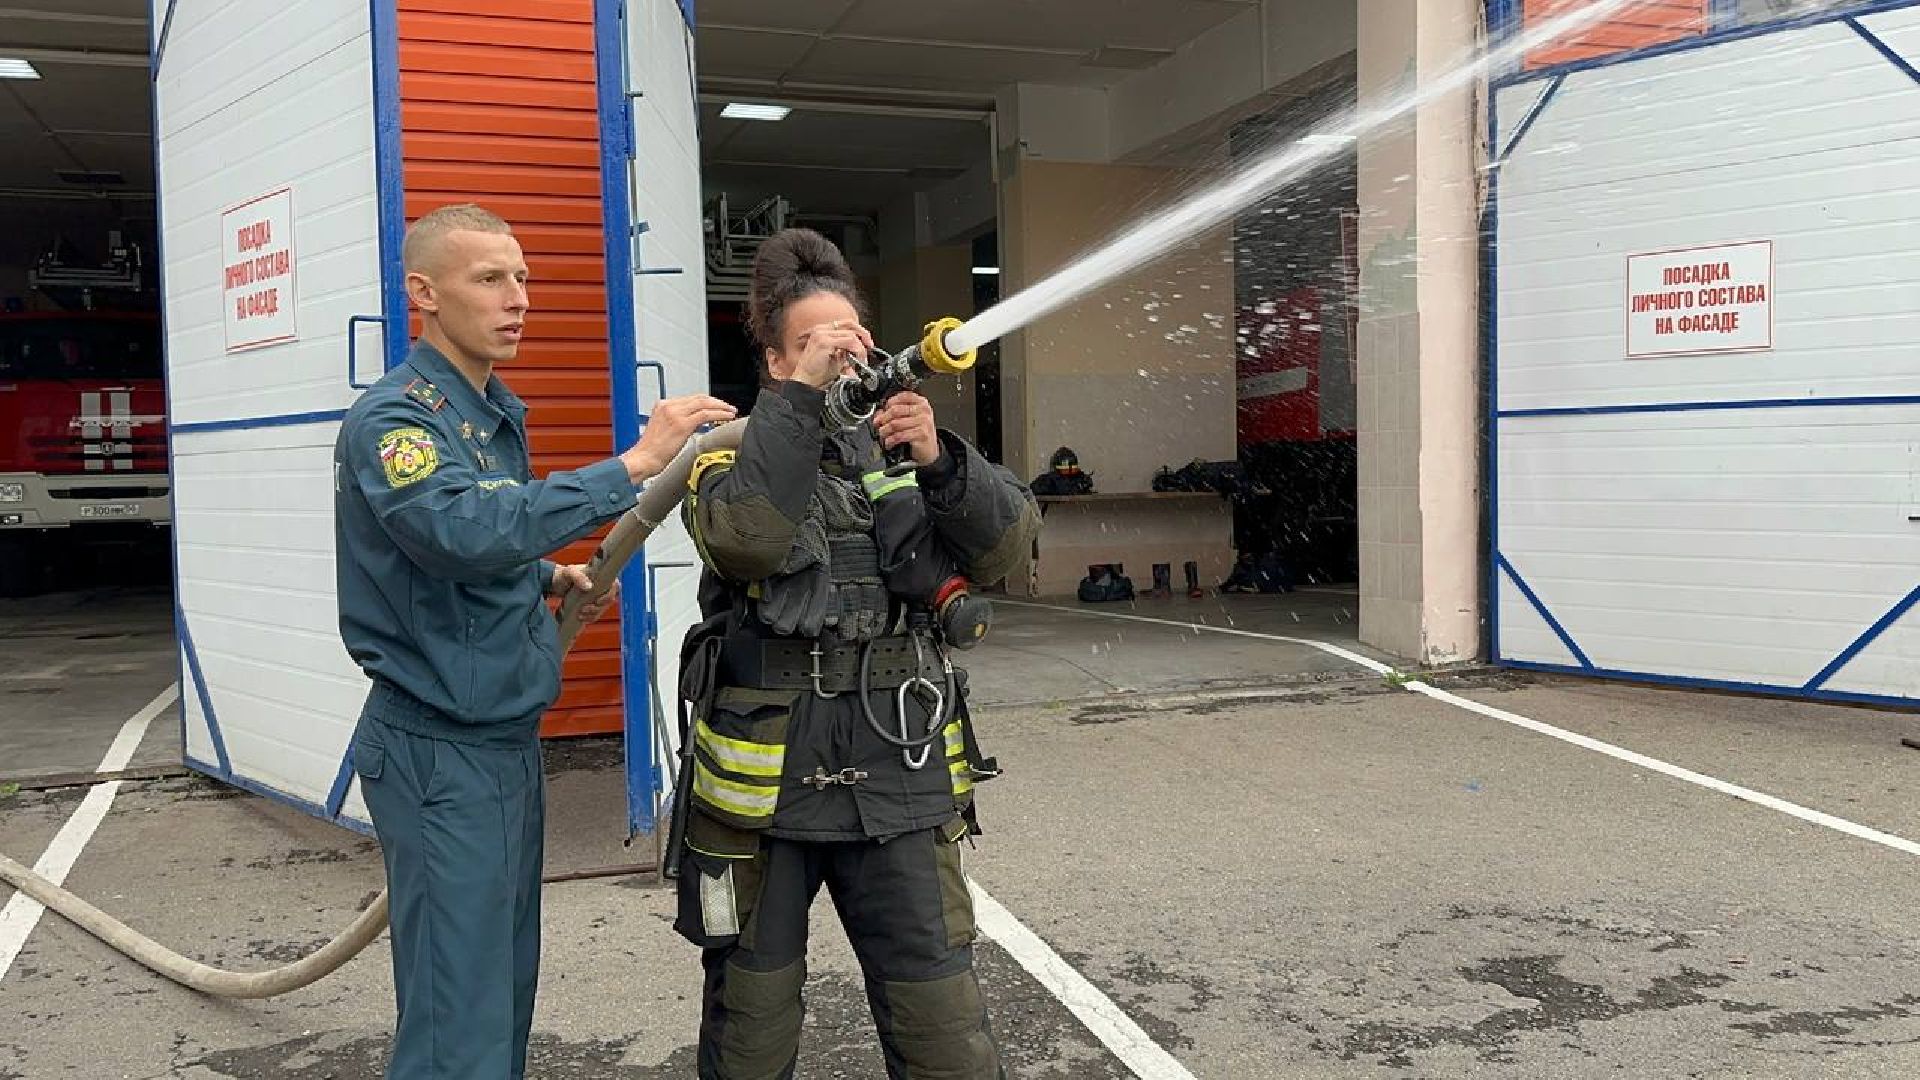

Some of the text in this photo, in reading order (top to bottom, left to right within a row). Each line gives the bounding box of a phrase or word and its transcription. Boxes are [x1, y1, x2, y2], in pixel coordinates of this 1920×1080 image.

[1663, 262, 1730, 285] ПОСАДКА
[1632, 285, 1765, 313] ЛИЧНОГО СОСТАВА
[1655, 312, 1739, 334] НА ФАСАДЕ
